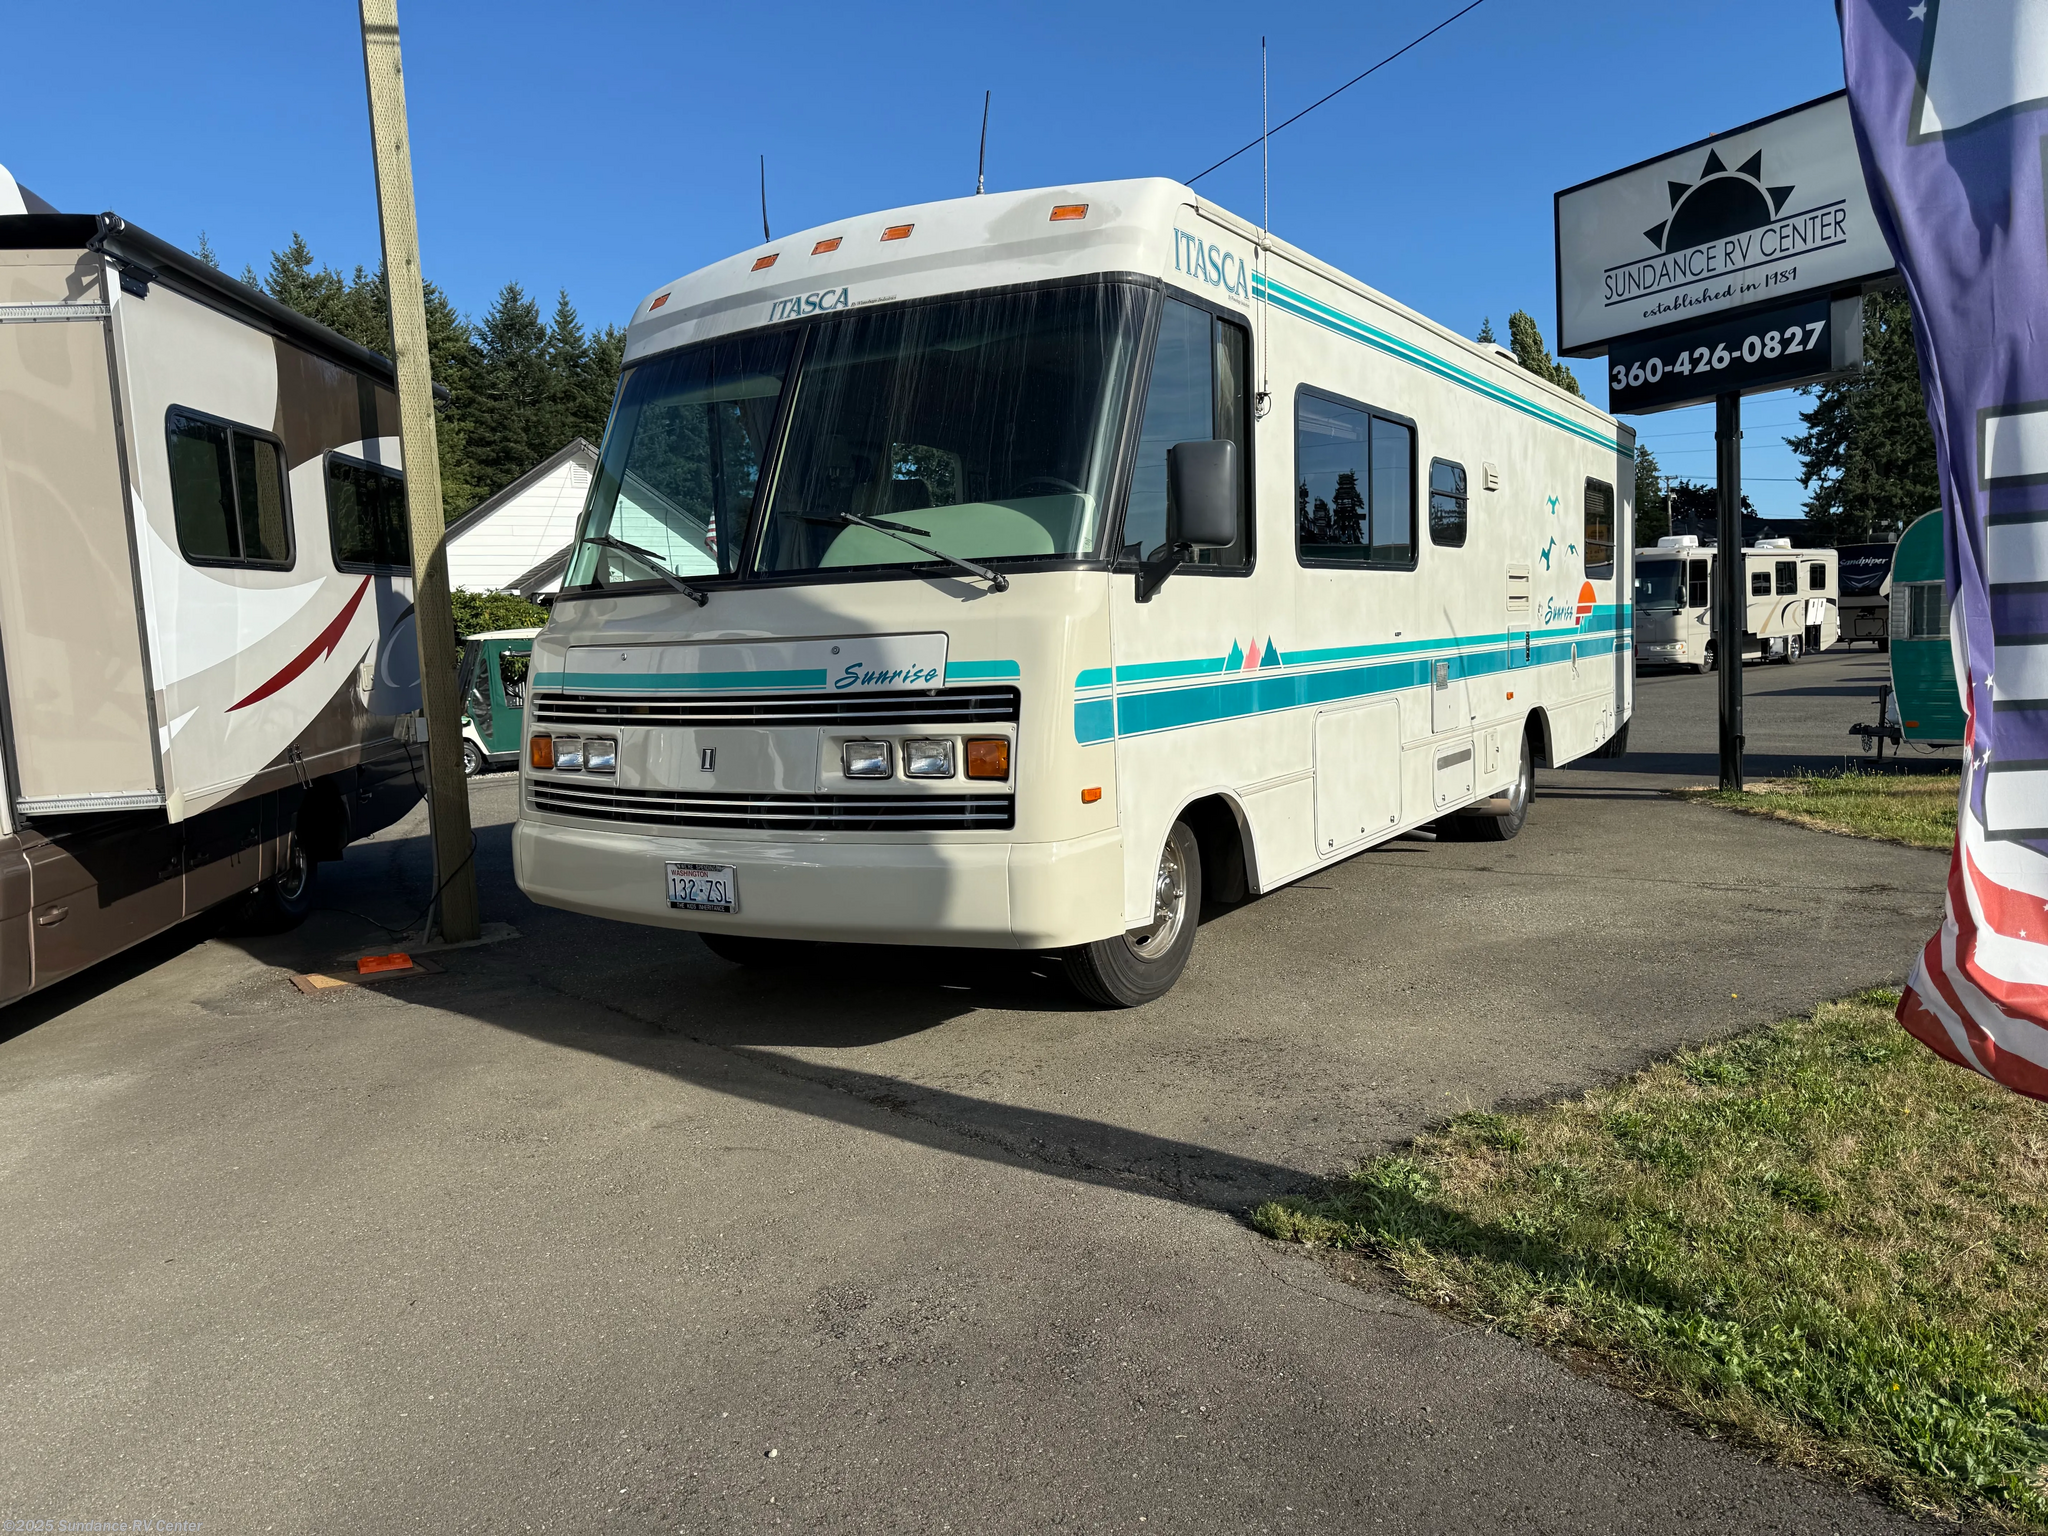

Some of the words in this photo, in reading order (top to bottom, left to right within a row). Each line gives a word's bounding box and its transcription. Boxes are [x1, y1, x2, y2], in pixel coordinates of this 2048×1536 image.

[1173, 227, 1249, 300] ITASCA
[1604, 245, 1717, 300] SUNDANCE
[1724, 235, 1753, 269] RV
[1759, 208, 1847, 257] CENTER
[768, 286, 849, 322] ITASCA
[1643, 285, 1737, 318] established
[1740, 281, 1761, 294] in
[1765, 266, 1797, 288] 1989
[1611, 320, 1826, 390] 360-426-0827
[1838, 556, 1889, 567] Sandpiper
[834, 662, 938, 689] Sunrise
[671, 869, 709, 878] WASHINGTON
